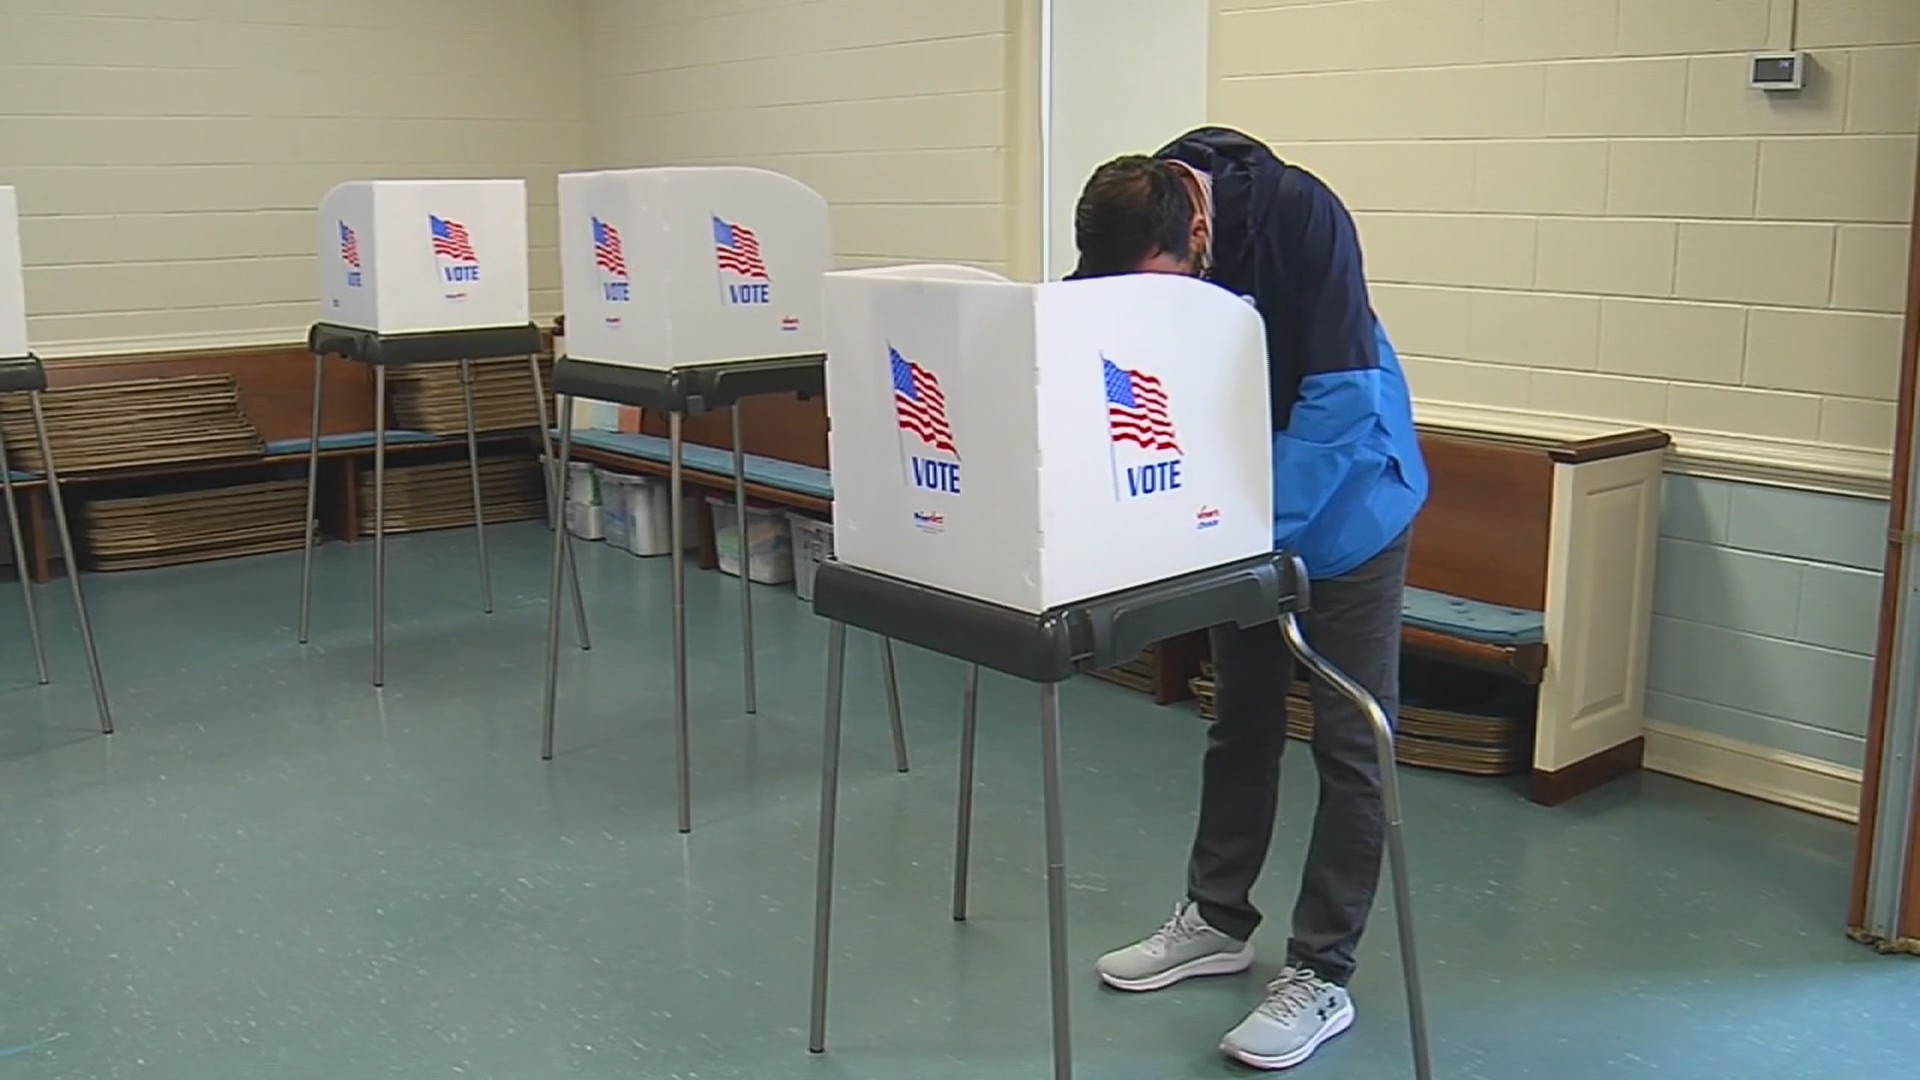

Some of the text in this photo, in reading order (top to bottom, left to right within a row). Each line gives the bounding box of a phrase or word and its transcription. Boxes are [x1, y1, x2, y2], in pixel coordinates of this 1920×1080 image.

[444, 265, 480, 281] VOTE
[729, 284, 769, 304] VOTE
[912, 456, 961, 494] VOTE
[1127, 459, 1182, 497] VOTE
